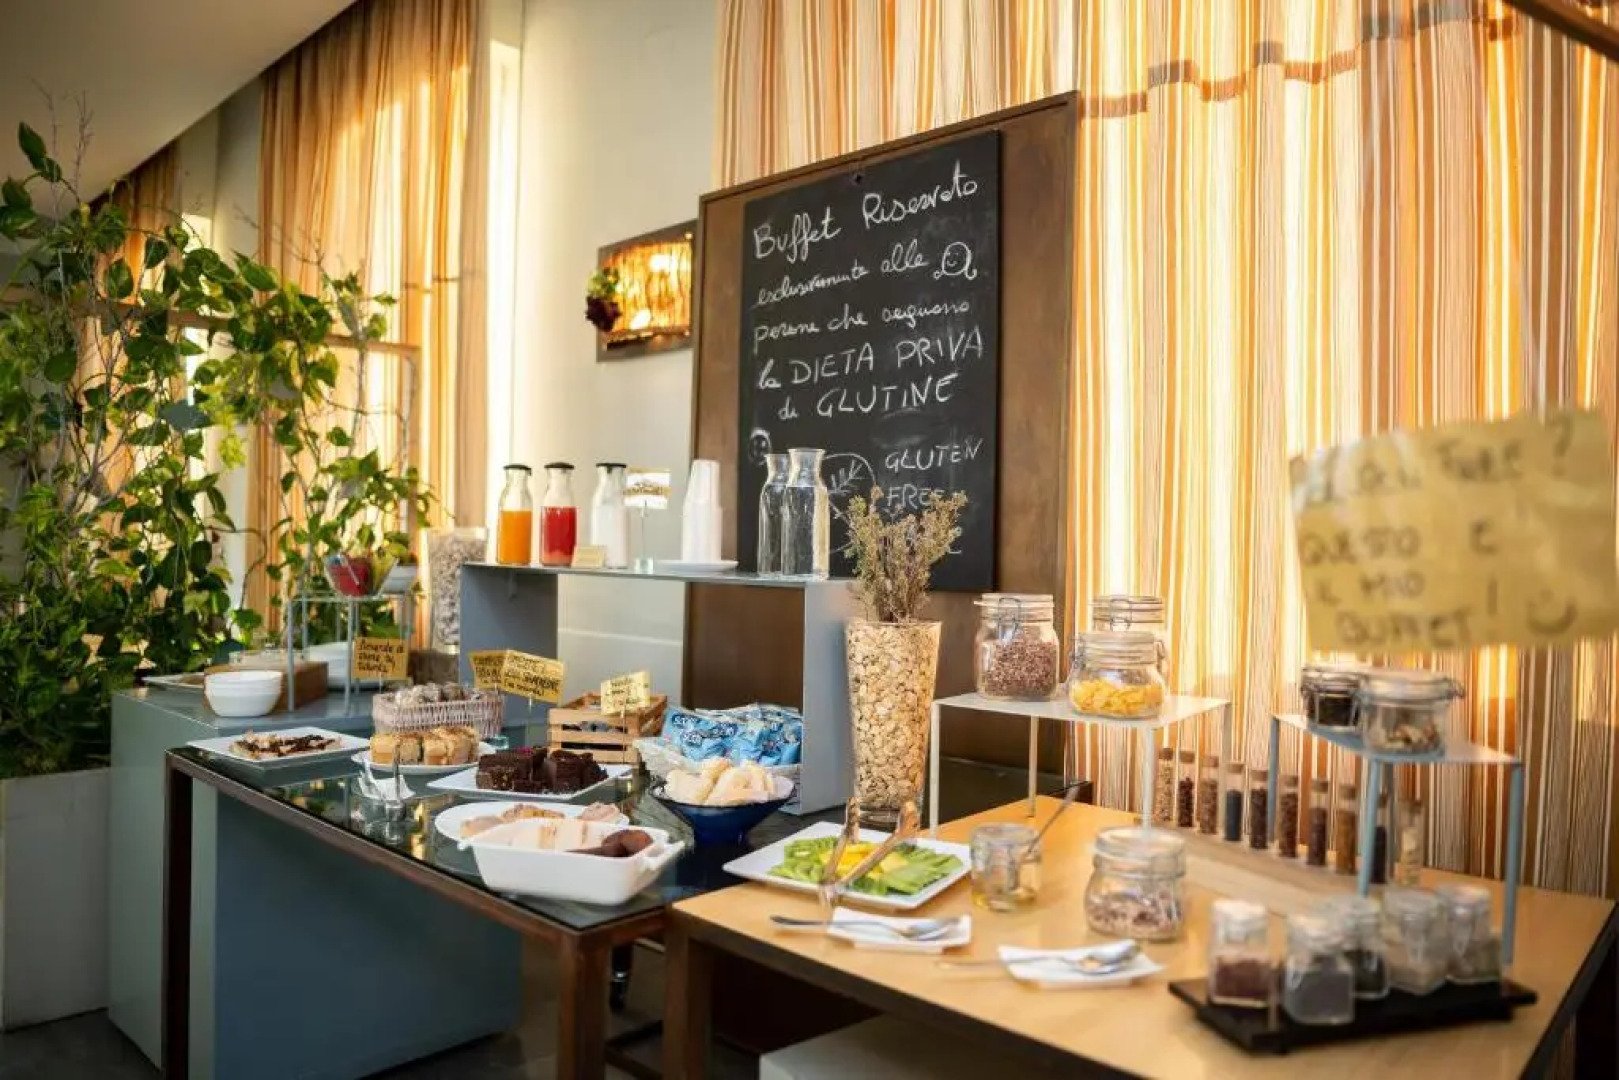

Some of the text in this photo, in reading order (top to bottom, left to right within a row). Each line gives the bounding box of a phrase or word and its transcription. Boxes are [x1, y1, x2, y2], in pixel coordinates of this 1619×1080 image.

[753, 205, 842, 264] Buffet
[880, 239, 929, 272] alle
[827, 303, 869, 331] che
[789, 342, 874, 384] DIETA
[895, 324, 984, 368] PRIVA
[816, 372, 959, 419] GLUTINE
[884, 437, 984, 474] GLUTEN
